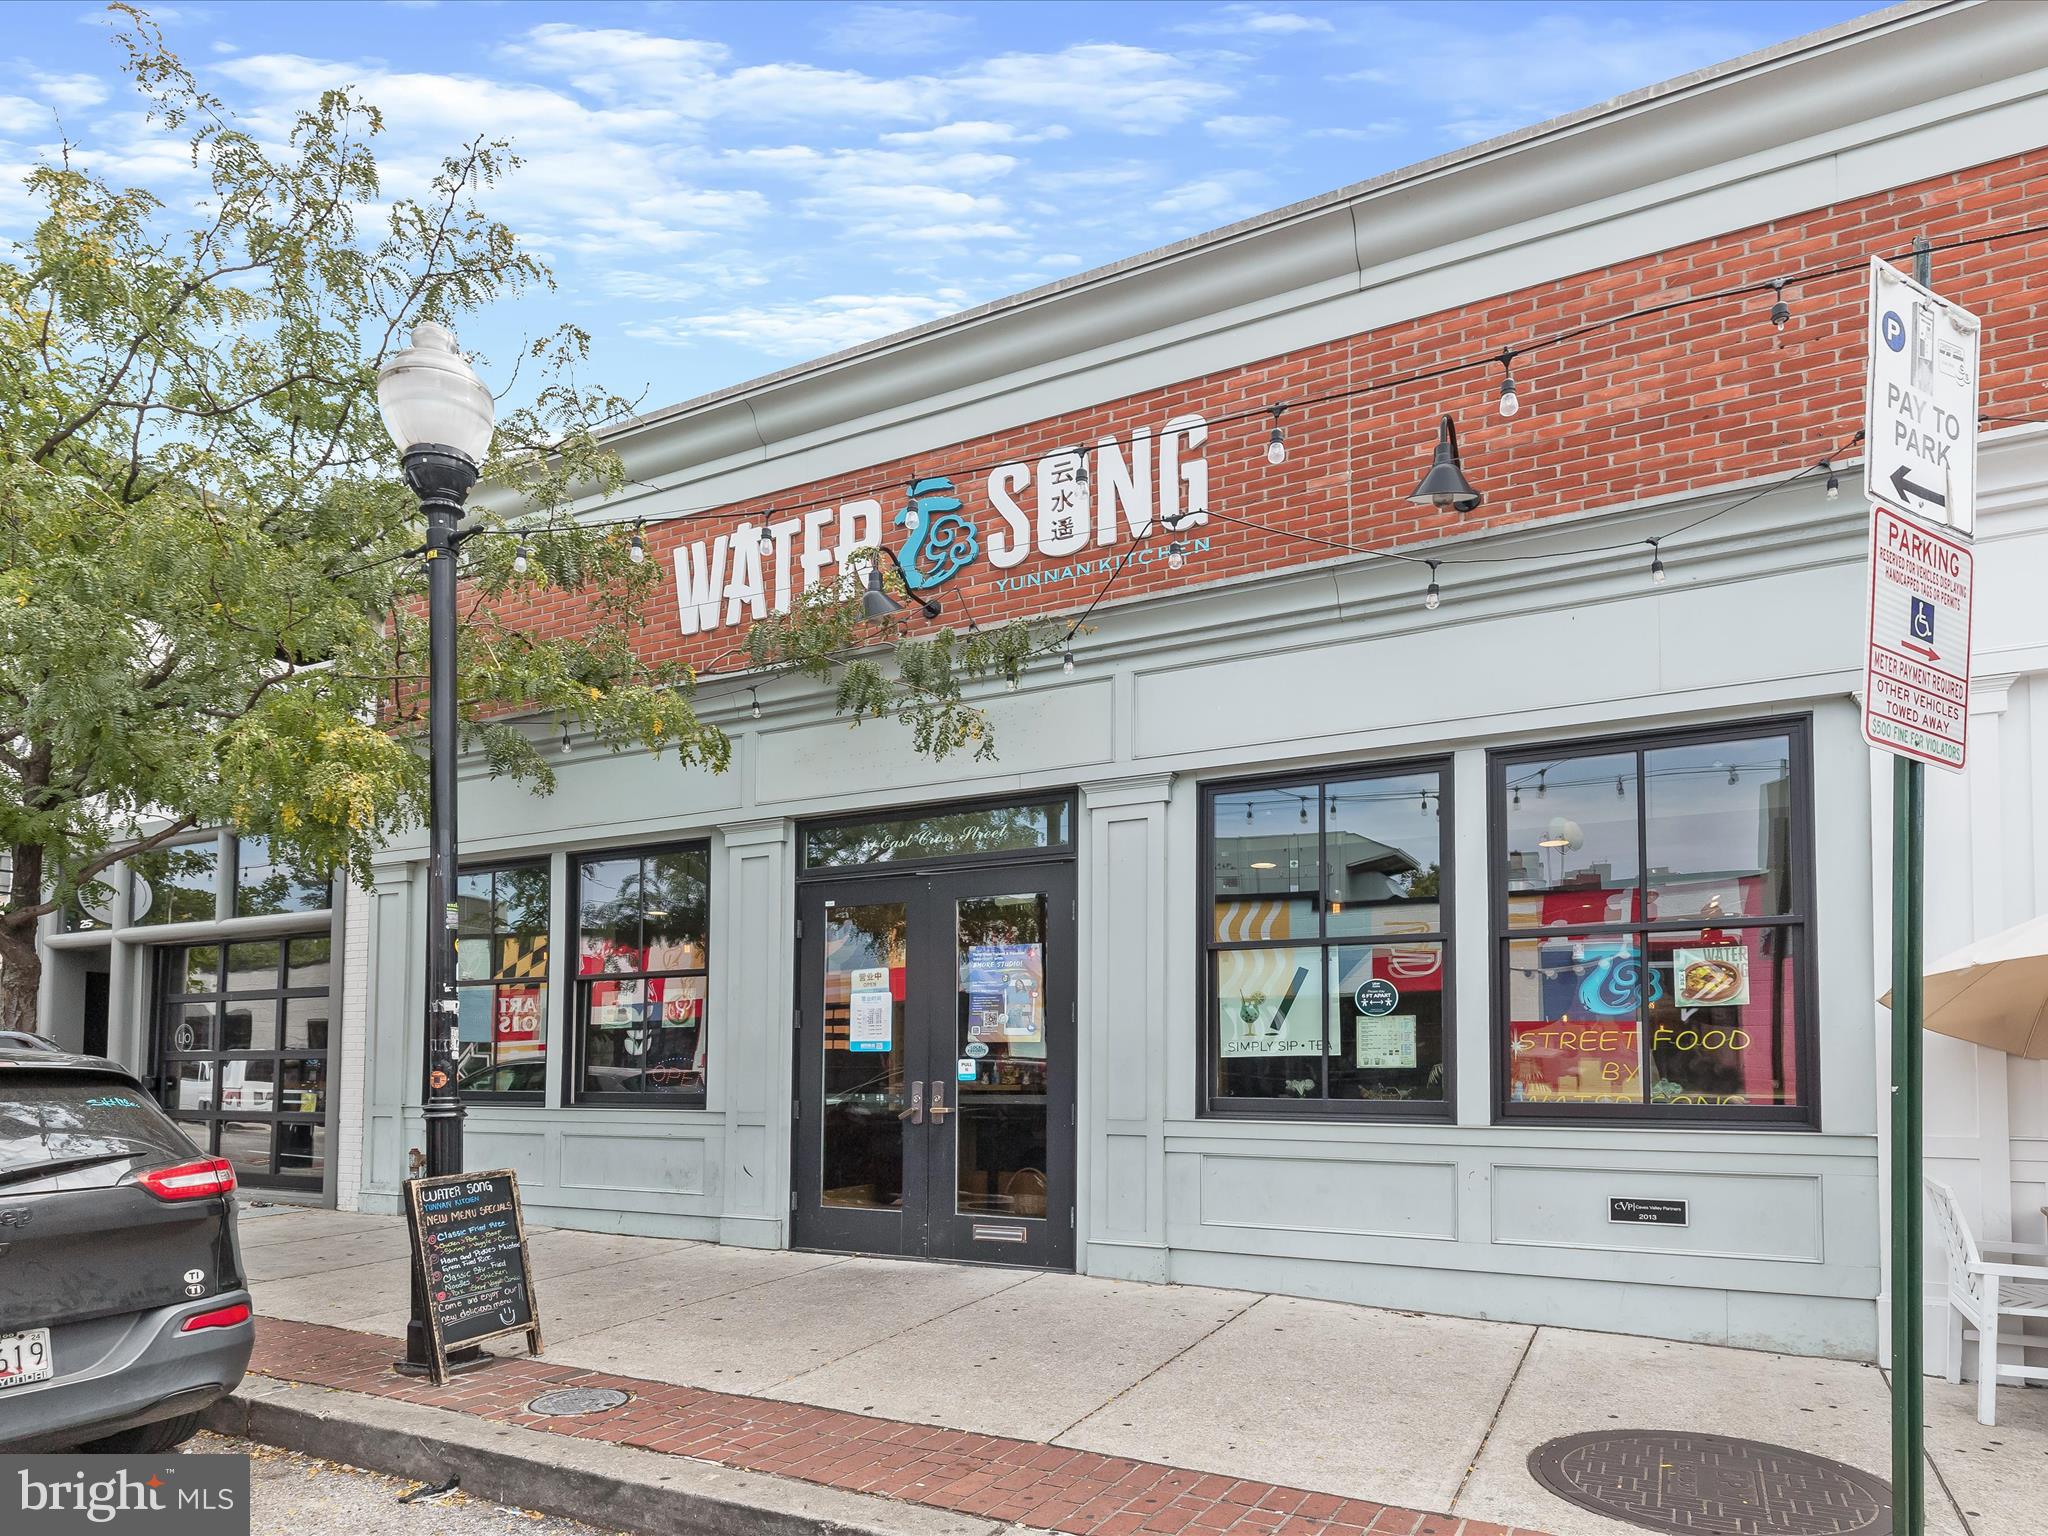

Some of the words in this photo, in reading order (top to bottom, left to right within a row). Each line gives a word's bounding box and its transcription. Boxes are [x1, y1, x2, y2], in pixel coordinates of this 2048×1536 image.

[1888, 382, 1926, 425] PAY
[1932, 405, 1960, 440] TO
[1895, 420, 1951, 470] PARK
[674, 498, 883, 636] WATER
[987, 413, 1209, 569] SONG
[1889, 521, 1959, 578] PARKING
[995, 562, 1091, 593] YUNNAN
[1099, 537, 1211, 574] KITCHEN
[1880, 547, 1905, 570] RESERVED
[1906, 557, 1916, 573] FOR
[1916, 562, 1939, 586] VEHICLES
[1940, 573, 1966, 598] DISPLAYING
[1885, 568, 1919, 594] HANDICAPPED
[1920, 582, 1933, 598] TAGS
[1934, 588, 1940, 601] OR
[1941, 592, 1960, 611] PERMITS
[1874, 651, 1897, 674] METER
[1900, 661, 1931, 686] PAYMENT
[1932, 673, 1964, 700] REQUIRED
[1877, 679, 1910, 702] OTHER
[1913, 693, 1959, 720] VEHICLES
[1886, 700, 1918, 723] TOWED
[1922, 715, 1950, 734] AWAY
[1873, 719, 1891, 737] $500
[1894, 728, 1909, 744] FINE
[1910, 733, 1924, 749] FOR
[1925, 737, 1960, 761] VIOLATORS
[881, 834, 913, 850] East
[915, 829, 956, 846] Cross
[960, 824, 1007, 842] Street
[1703, 947, 1747, 961] WATER
[1228, 1041, 1274, 1053] SIMPLY
[1278, 1040, 1299, 1052] SIP
[1519, 1030, 1642, 1051] STREET
[1653, 1029, 1751, 1051] FOOD
[1602, 1062, 1641, 1081] BY
[422, 1185, 461, 1202] WATER
[466, 1181, 493, 1194] SONG
[426, 1214, 448, 1227] NEW
[450, 1208, 477, 1222] MENU
[480, 1201, 513, 1216] SPECIALS
[437, 1229, 467, 1241] Classic
[468, 1223, 486, 1234] Fried
[440, 1256, 458, 1265] Ham
[460, 1252, 472, 1260] and
[442, 1270, 471, 1283] Classic
[438, 1301, 462, 1312] Come
[467, 1296, 478, 1305] and
[441, 1314, 457, 1323] new
[460, 1304, 492, 1318] delicious
[493, 1299, 513, 1309] menu
